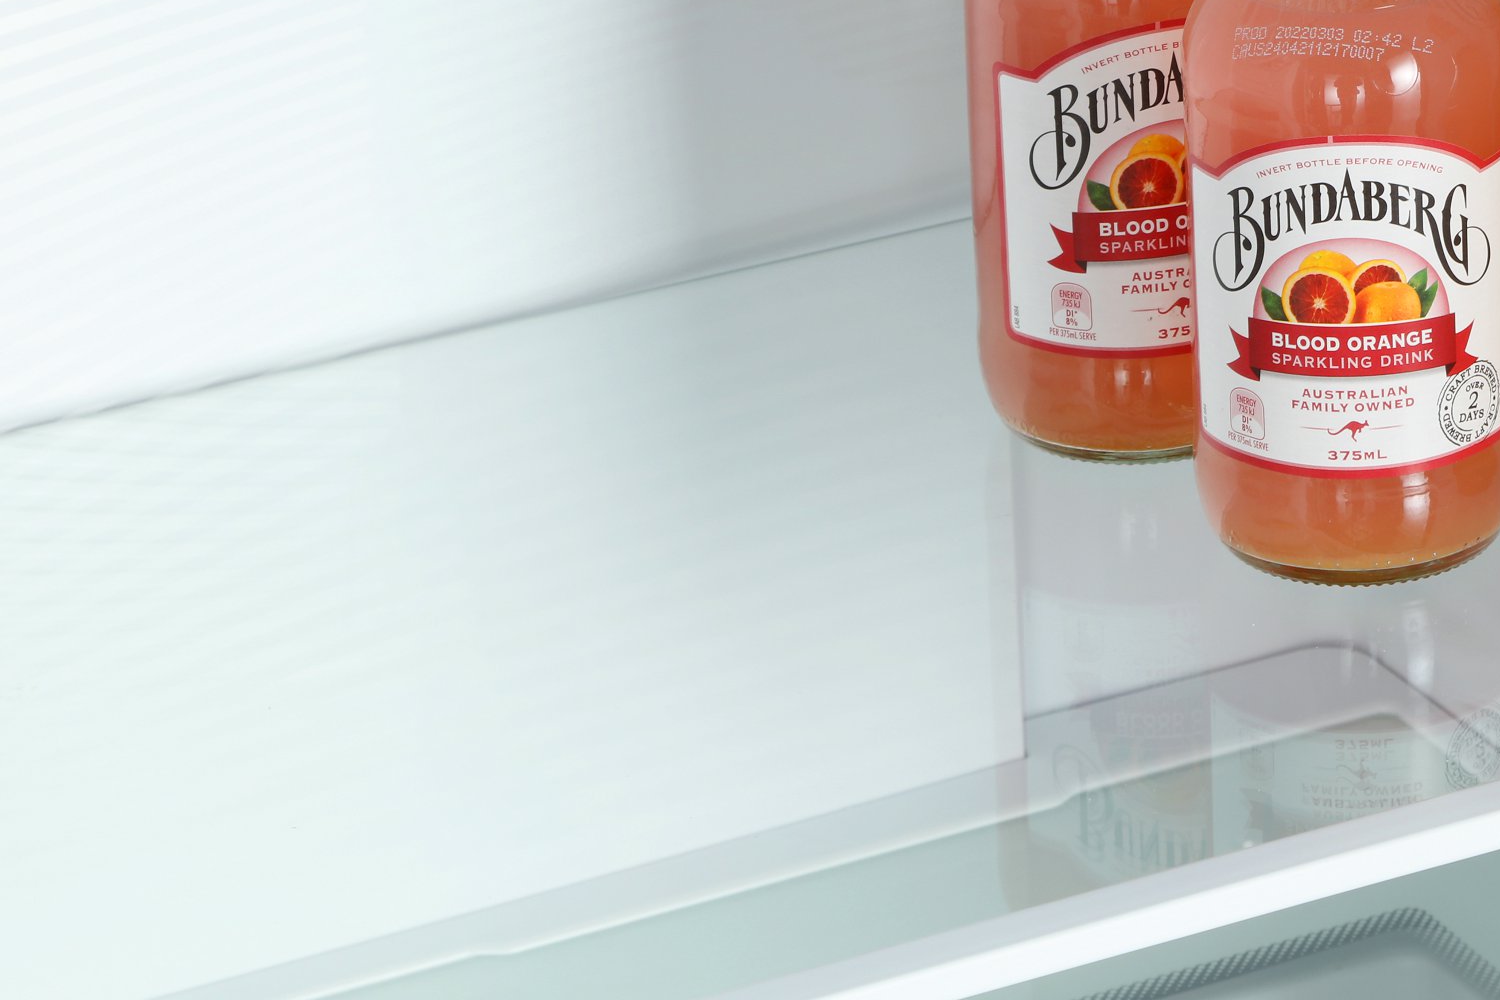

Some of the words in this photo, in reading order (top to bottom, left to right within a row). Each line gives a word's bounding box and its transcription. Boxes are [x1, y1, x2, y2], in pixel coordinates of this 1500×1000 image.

[1234, 27, 1267, 41] PROD
[1275, 26, 1344, 41] 20220303
[1353, 29, 1402, 48] 02:42
[1411, 36, 1434, 54] L2
[1081, 55, 1120, 75] INVERT
[1124, 43, 1168, 59] BOTTLE
[1256, 163, 1292, 179] INVERT
[1296, 158, 1342, 170] BOTTLE
[1346, 157, 1393, 167] BEFORE
[1397, 159, 1444, 175] OPENING
[1099, 218, 1169, 237] BLOOD
[1213, 168, 1491, 292] BUNDABERG
[1059, 290, 1083, 300] ENERGY
[1121, 281, 1178, 295] FAMILY
[1062, 299, 1073, 308] 735
[1073, 299, 1081, 308] kJ
[1066, 318, 1078, 327] 8%
[1049, 327, 1060, 337] PER
[1060, 328, 1078, 340] 375mL
[1079, 332, 1097, 341] SERVE
[1271, 331, 1340, 352] BLOOD
[1347, 328, 1433, 351] ORANGE
[1271, 352, 1373, 370] SPARKLING
[1380, 349, 1434, 368] DRINK
[1445, 368, 1472, 402] CRAFT
[1473, 364, 1497, 393] BREWED
[1465, 381, 1485, 393] OVER
[1302, 385, 1409, 400] AUSTRALIAN
[1236, 394, 1257, 408] ENERGY
[1291, 399, 1349, 413] FAMILY
[1355, 397, 1415, 413] OWNED
[1468, 391, 1479, 410] 2
[1238, 404, 1248, 414] 735
[1459, 409, 1485, 423] DAYS
[1241, 423, 1253, 434] 8%
[1227, 430, 1237, 441] PER
[1252, 440, 1269, 452] SERVE
